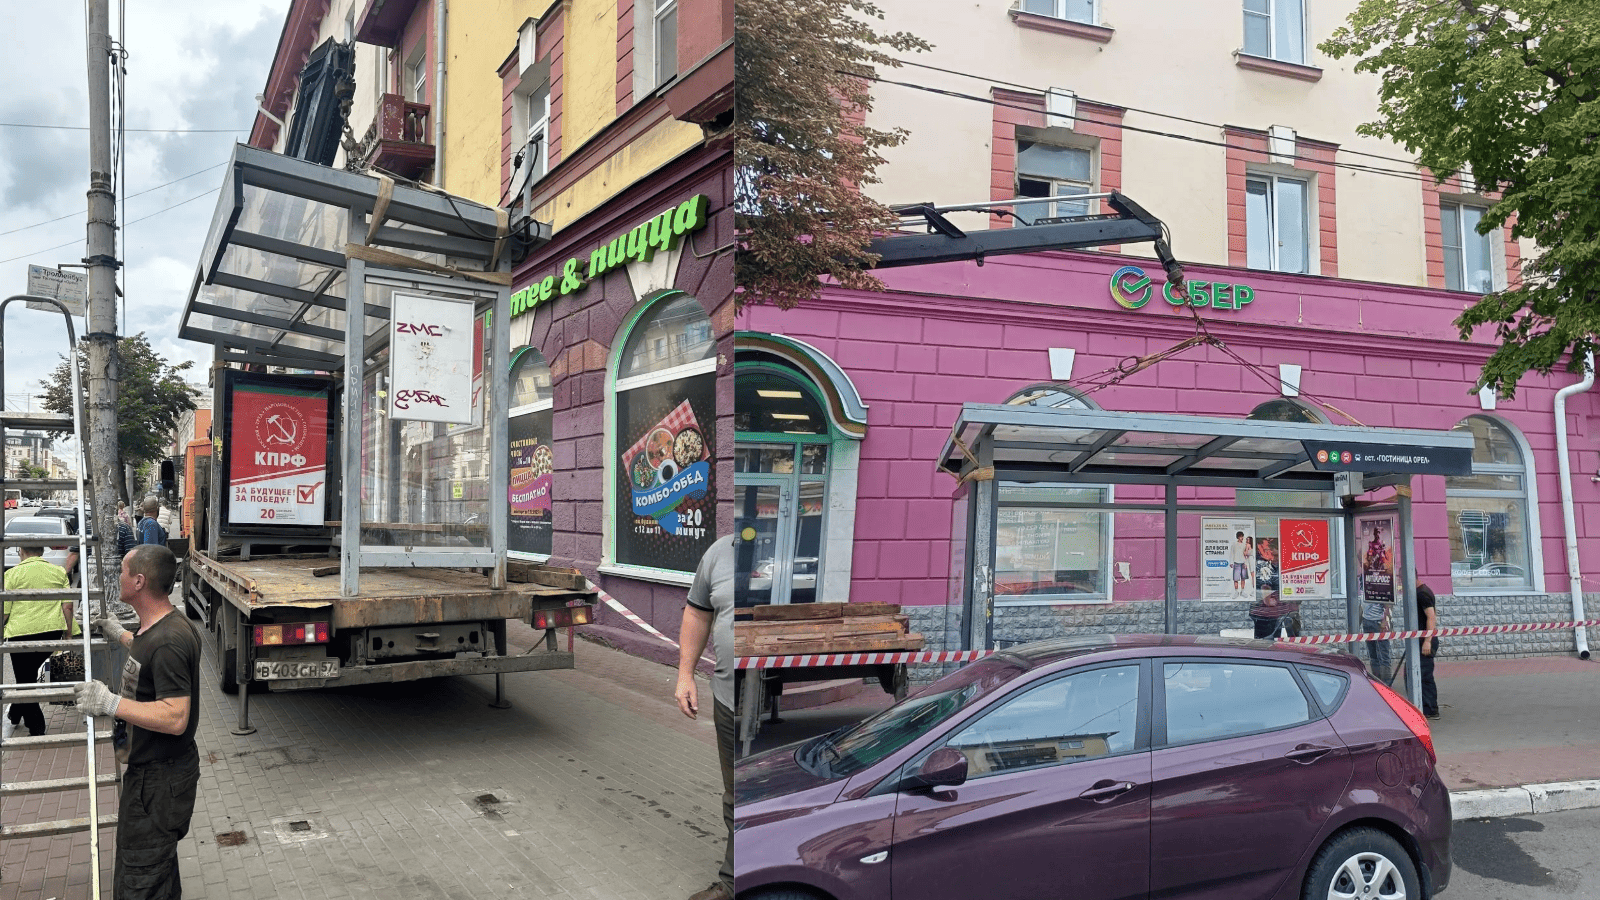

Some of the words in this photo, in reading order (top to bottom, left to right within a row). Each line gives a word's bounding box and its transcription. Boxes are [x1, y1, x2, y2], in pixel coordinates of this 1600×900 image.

[561, 257, 582, 295] &
[589, 194, 703, 278] пицца
[1162, 279, 1255, 310] СБЕР
[255, 451, 307, 467] КПРФ
[235, 486, 247, 494] ЗА
[250, 487, 296, 496] БУДУЩЕЕ!
[635, 470, 704, 507] КОМБО-ОБЕД
[235, 494, 247, 502] ЗА
[250, 495, 289, 504] ПОБЕДУ!
[260, 508, 275, 519] 20
[677, 513, 686, 523] за
[686, 508, 702, 526] 20
[1291, 552, 1320, 561] КПРФ
[320, 661, 334, 673] 57
